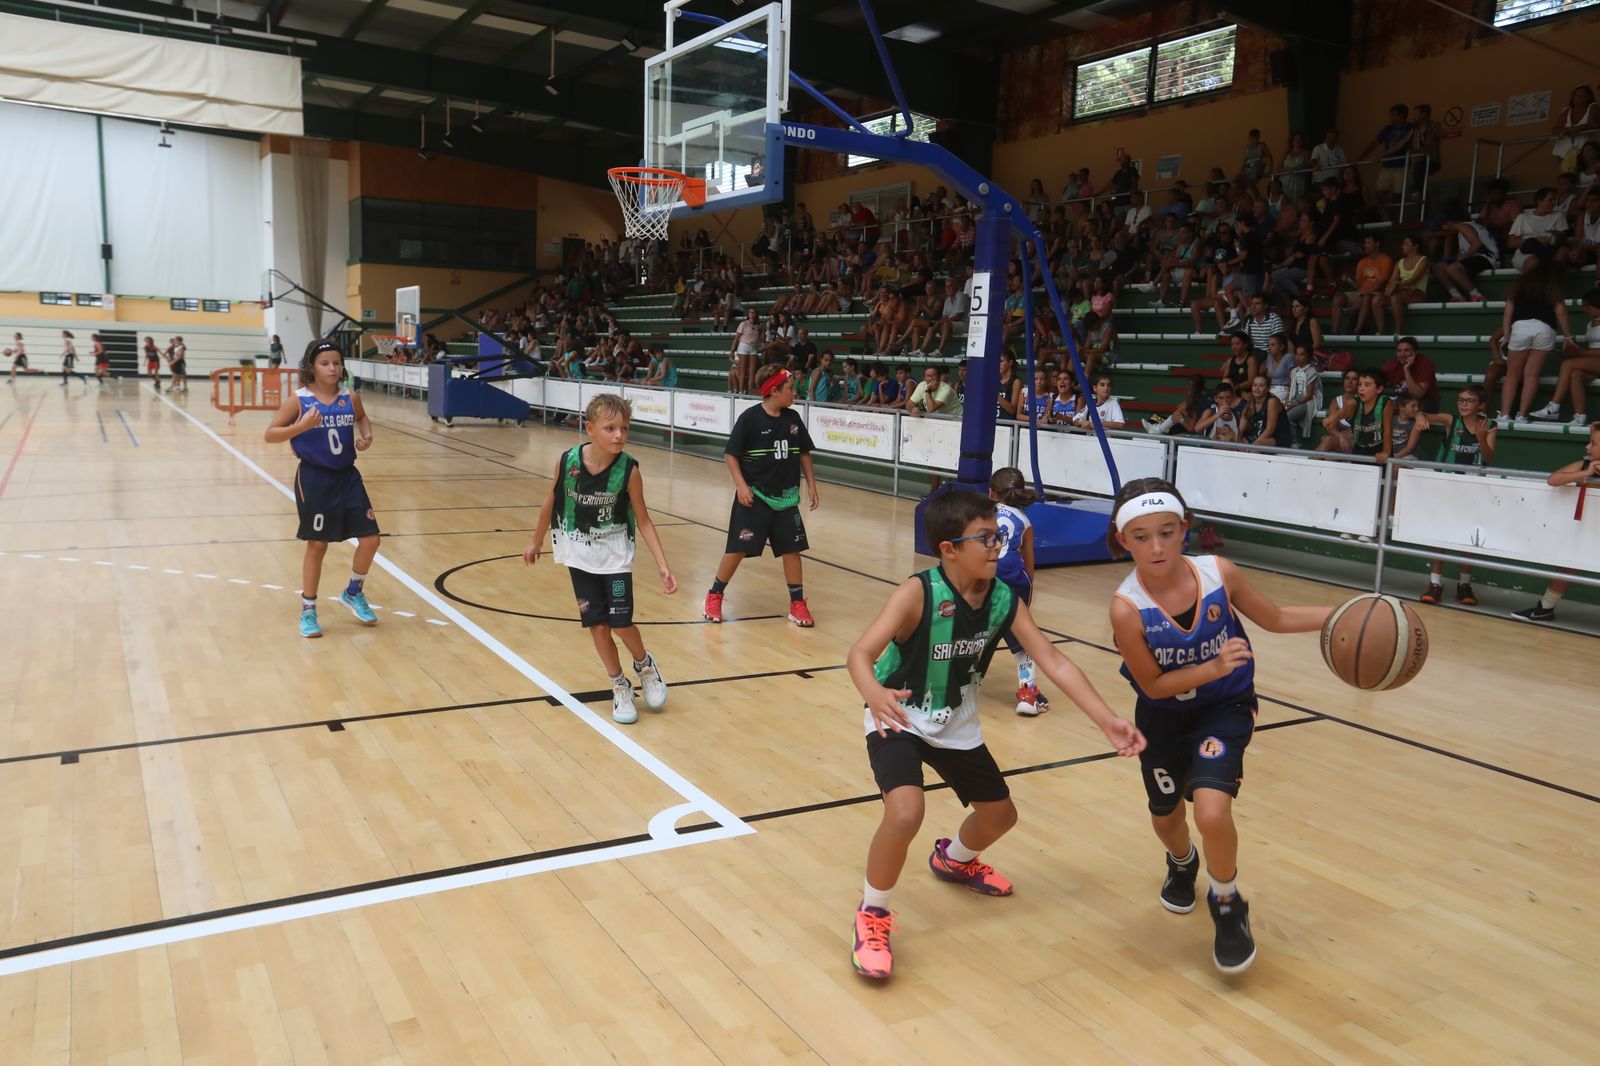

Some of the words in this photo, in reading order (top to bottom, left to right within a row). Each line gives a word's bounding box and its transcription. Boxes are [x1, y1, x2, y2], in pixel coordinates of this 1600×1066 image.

[783, 125, 816, 140] NDO
[971, 285, 983, 311] 5
[328, 428, 343, 455] 0
[774, 439, 789, 460] 39
[1141, 498, 1165, 507] FILA
[313, 513, 324, 532] 0
[597, 506, 613, 522] 23
[1404, 628, 1423, 678] molten
[1153, 767, 1176, 795] 6
